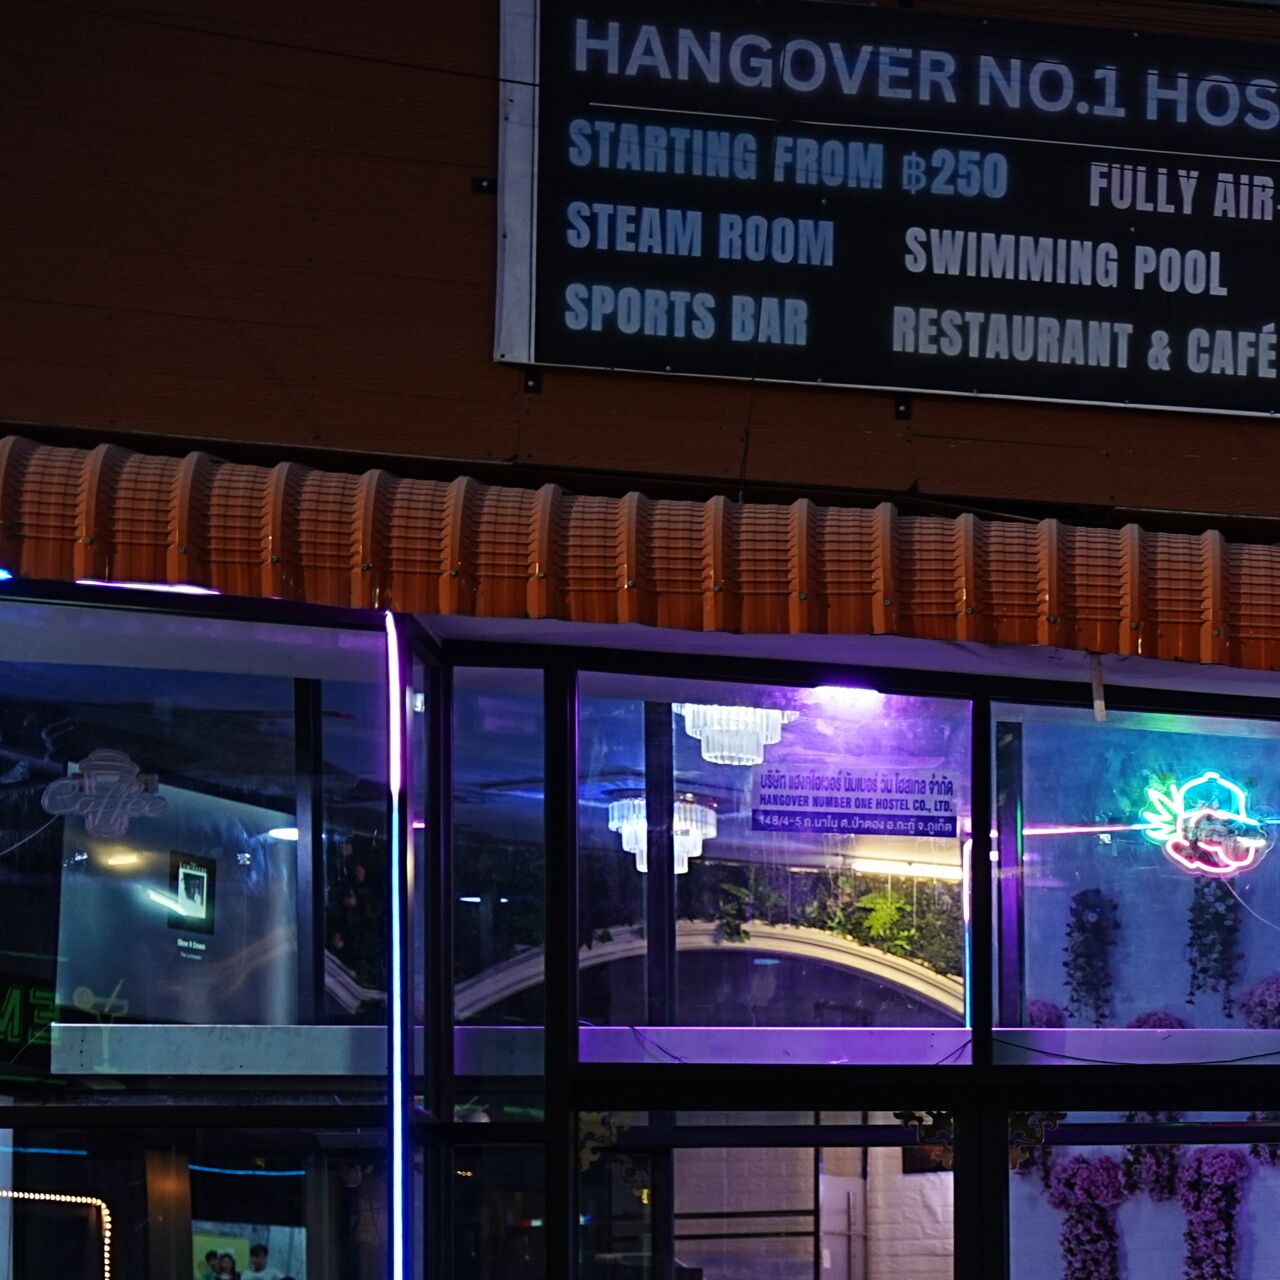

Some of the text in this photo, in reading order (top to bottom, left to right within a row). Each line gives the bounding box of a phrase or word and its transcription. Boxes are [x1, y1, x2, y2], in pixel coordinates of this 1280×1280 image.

[573, 18, 956, 104] HANGOVER
[977, 56, 1123, 119] NO.1
[568, 119, 757, 184] STARTING
[774, 137, 884, 191] FROM
[1089, 162, 1202, 216] FULLY
[566, 202, 835, 267] STEAM ROOM
[904, 227, 1228, 298] SWIMMING POOL
[564, 283, 808, 347] SPORTS BAR
[893, 305, 1278, 380] RESTAURANT & CAFÉ
[41, 777, 169, 827] Coffee
[760, 769, 786, 790] บริษัท
[928, 773, 954, 797] จำกัด
[760, 793, 954, 813] HANGOVER NUMBER ONE HOSTEL CO., LTD.
